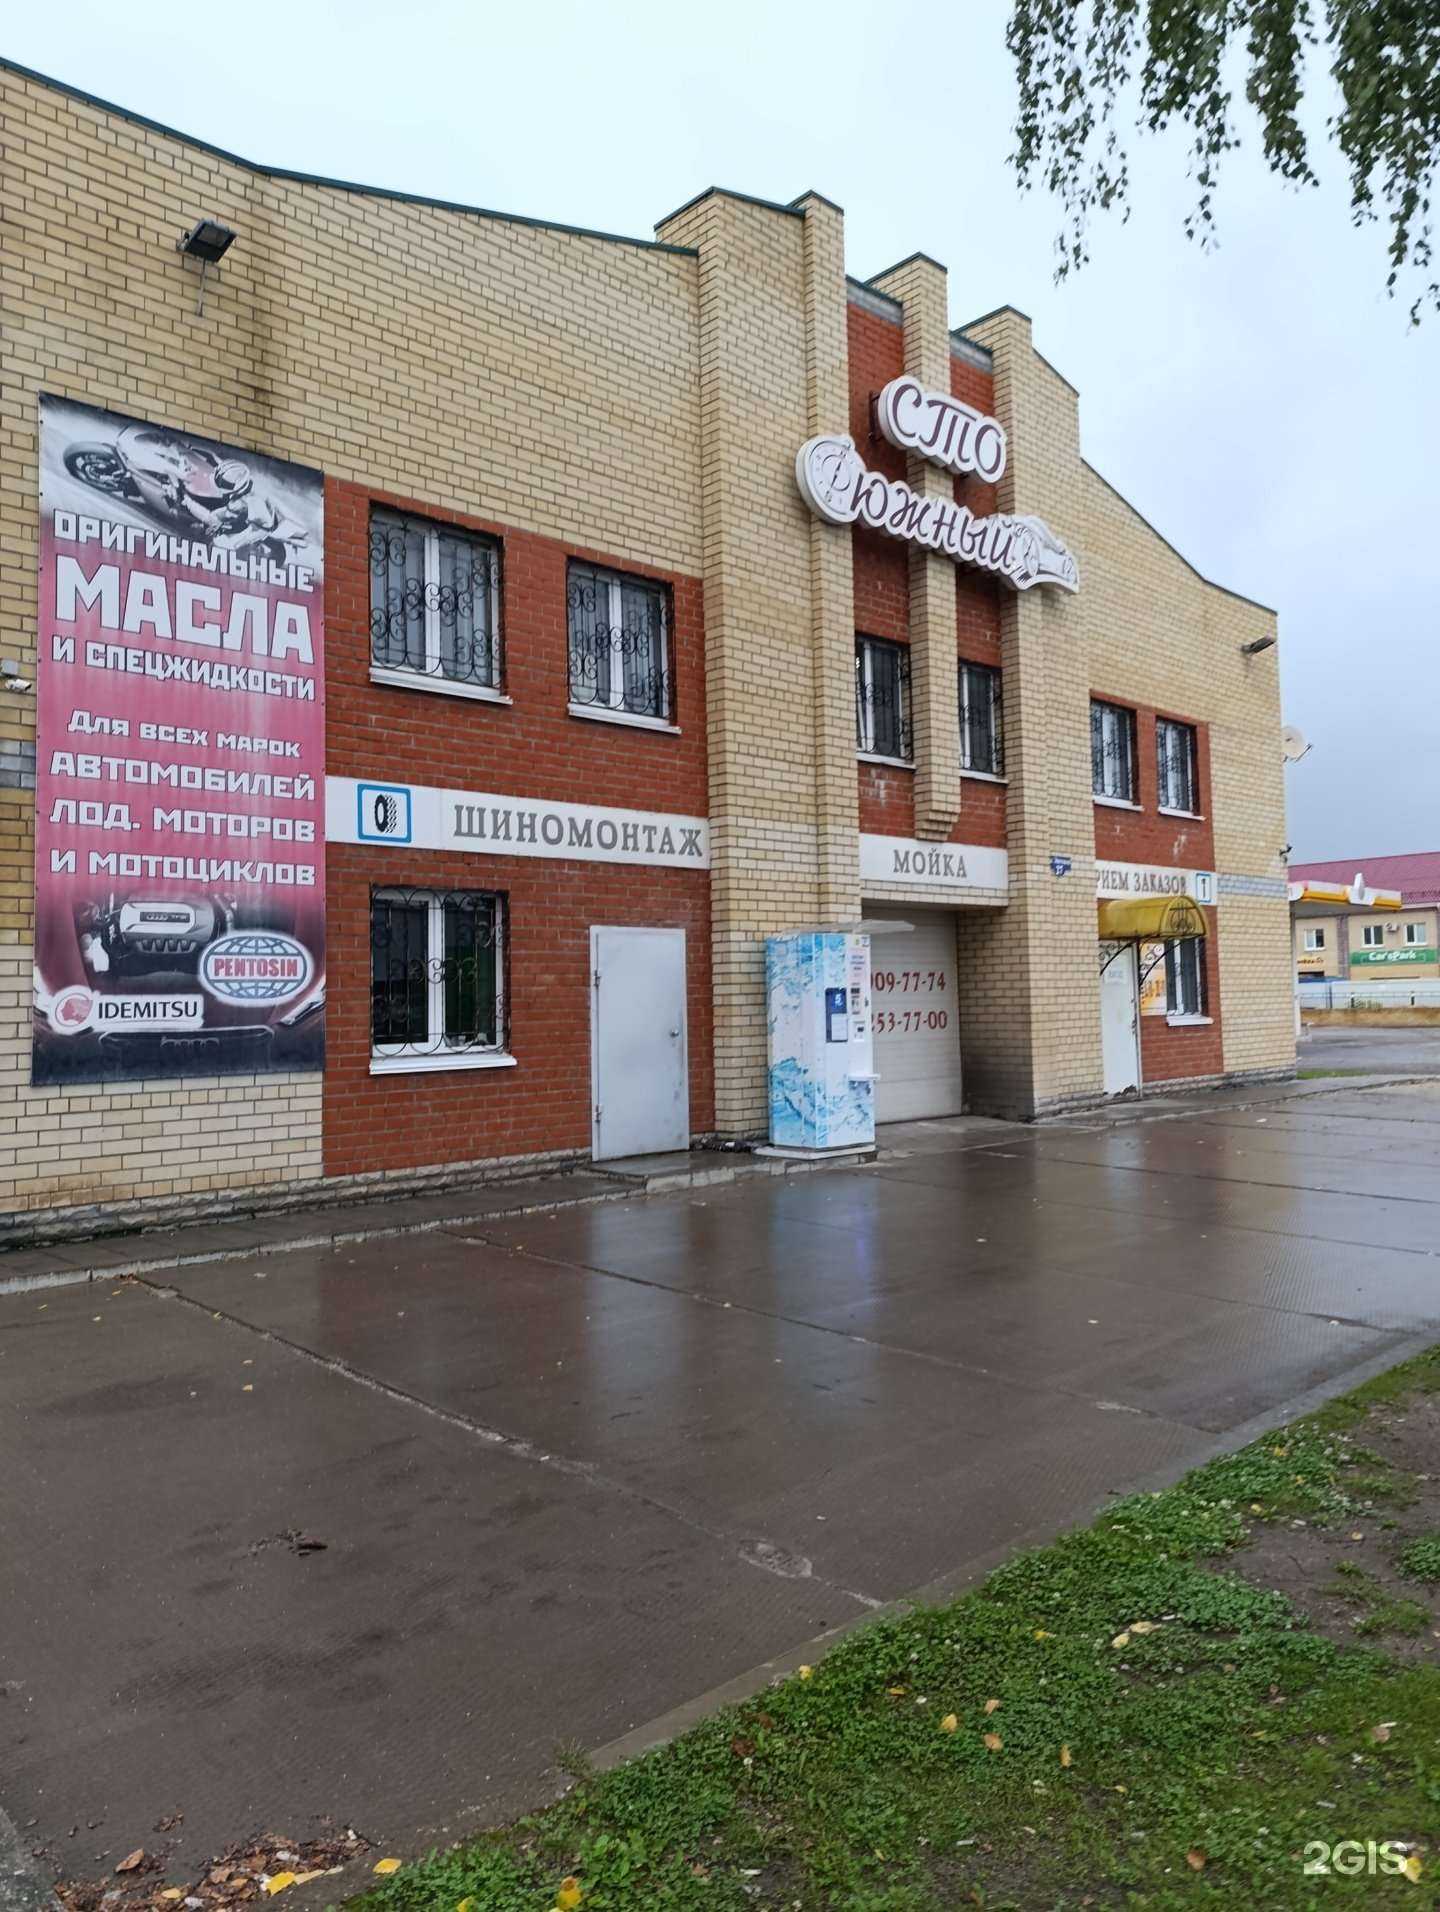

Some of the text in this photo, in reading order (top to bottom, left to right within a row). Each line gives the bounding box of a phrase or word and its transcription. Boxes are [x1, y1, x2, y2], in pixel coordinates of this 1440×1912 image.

[892, 383, 1002, 474] СТО
[53, 509, 314, 593] ОРИГИНАЛЬНЫЕ
[56, 554, 314, 664] МАСЛА
[52, 635, 315, 701] И СПЕЦЖИДКОСТИ
[50, 751, 315, 801] АВТОМОБИЛЕЙ
[49, 799, 315, 842] ЛОД. МОТОРОВ
[453, 804, 704, 857] ШИНОМОНТАЖ
[50, 849, 315, 885] И МОТОЦИКЛОВ
[893, 849, 967, 878] МОЙКА
[1134, 873, 1187, 894] ЗАКАЗОВ
[213, 958, 298, 978] PENTOSIN
[98, 999, 199, 1019] IDEMITSU
